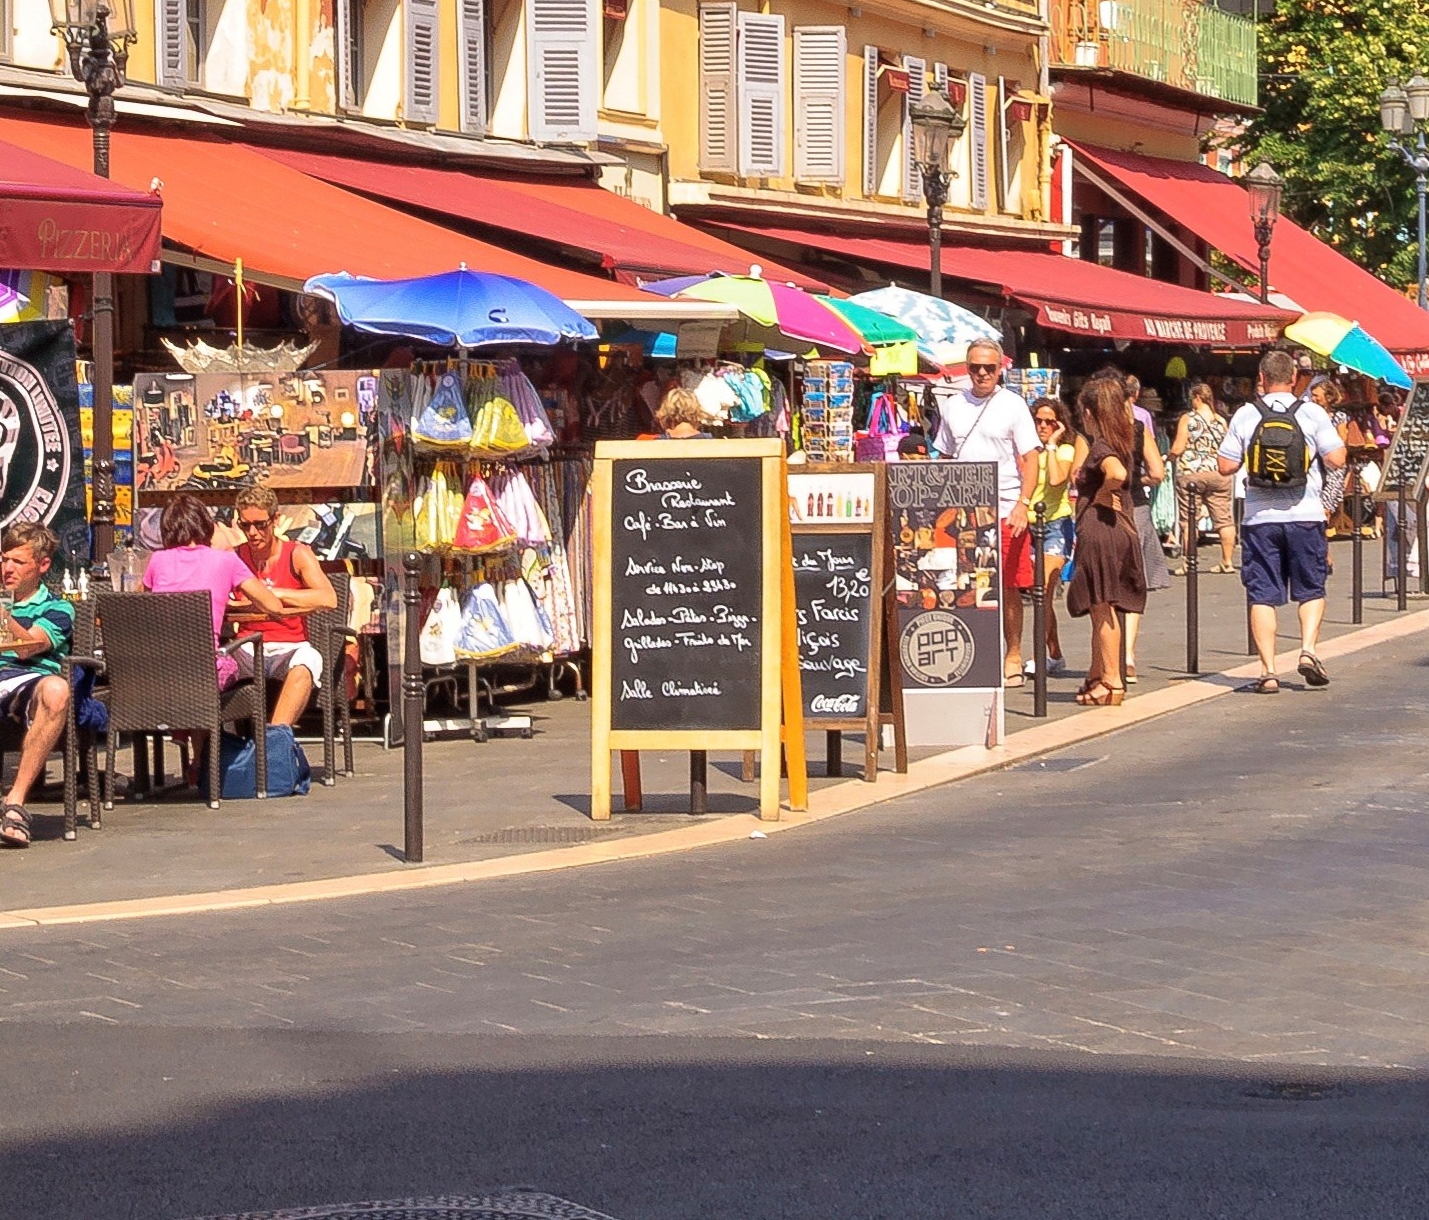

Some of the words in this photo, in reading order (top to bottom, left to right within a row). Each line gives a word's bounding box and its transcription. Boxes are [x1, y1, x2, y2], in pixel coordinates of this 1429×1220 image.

[37, 218, 135, 262] PIZZERIA
[625, 469, 702, 494] Brasserie
[889, 485, 994, 508] OP-ART
[705, 509, 726, 528] Vin
[811, 599, 859, 622] Farcis
[621, 679, 654, 701] Salle
